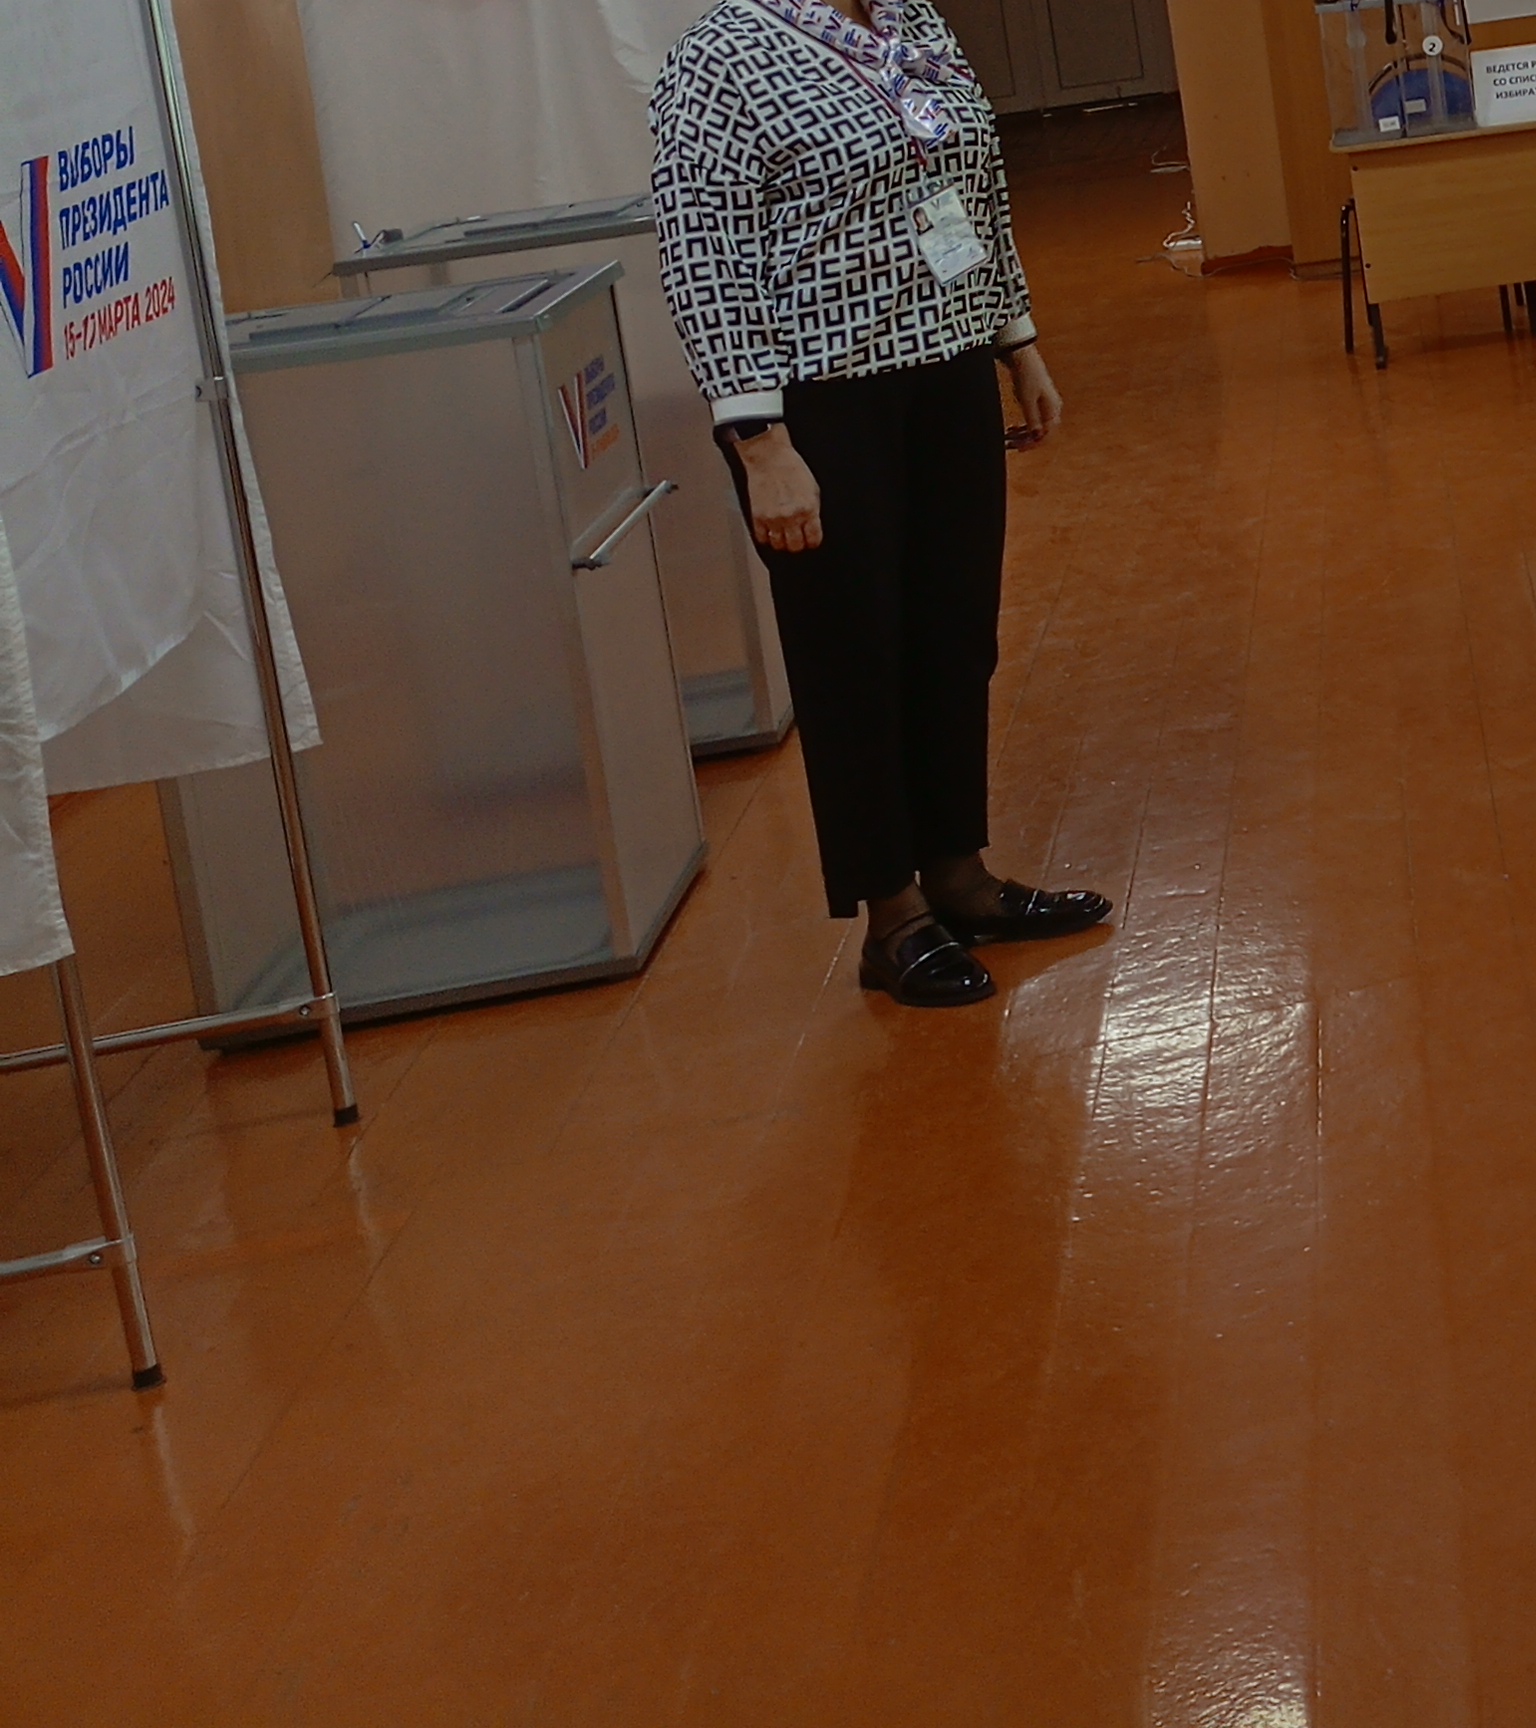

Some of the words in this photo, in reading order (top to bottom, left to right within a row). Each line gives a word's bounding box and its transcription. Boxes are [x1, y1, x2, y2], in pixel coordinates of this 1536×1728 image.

[1427, 42, 1437, 54] 2
[1485, 61, 1529, 74] ВЕДЕТСЯ
[1493, 77, 1507, 87] СО
[59, 169, 170, 250] ПРЕЗИДЕНТА
[62, 242, 130, 309] РОССИИ
[97, 293, 141, 345] МАРТА
[145, 276, 176, 323] 2024
